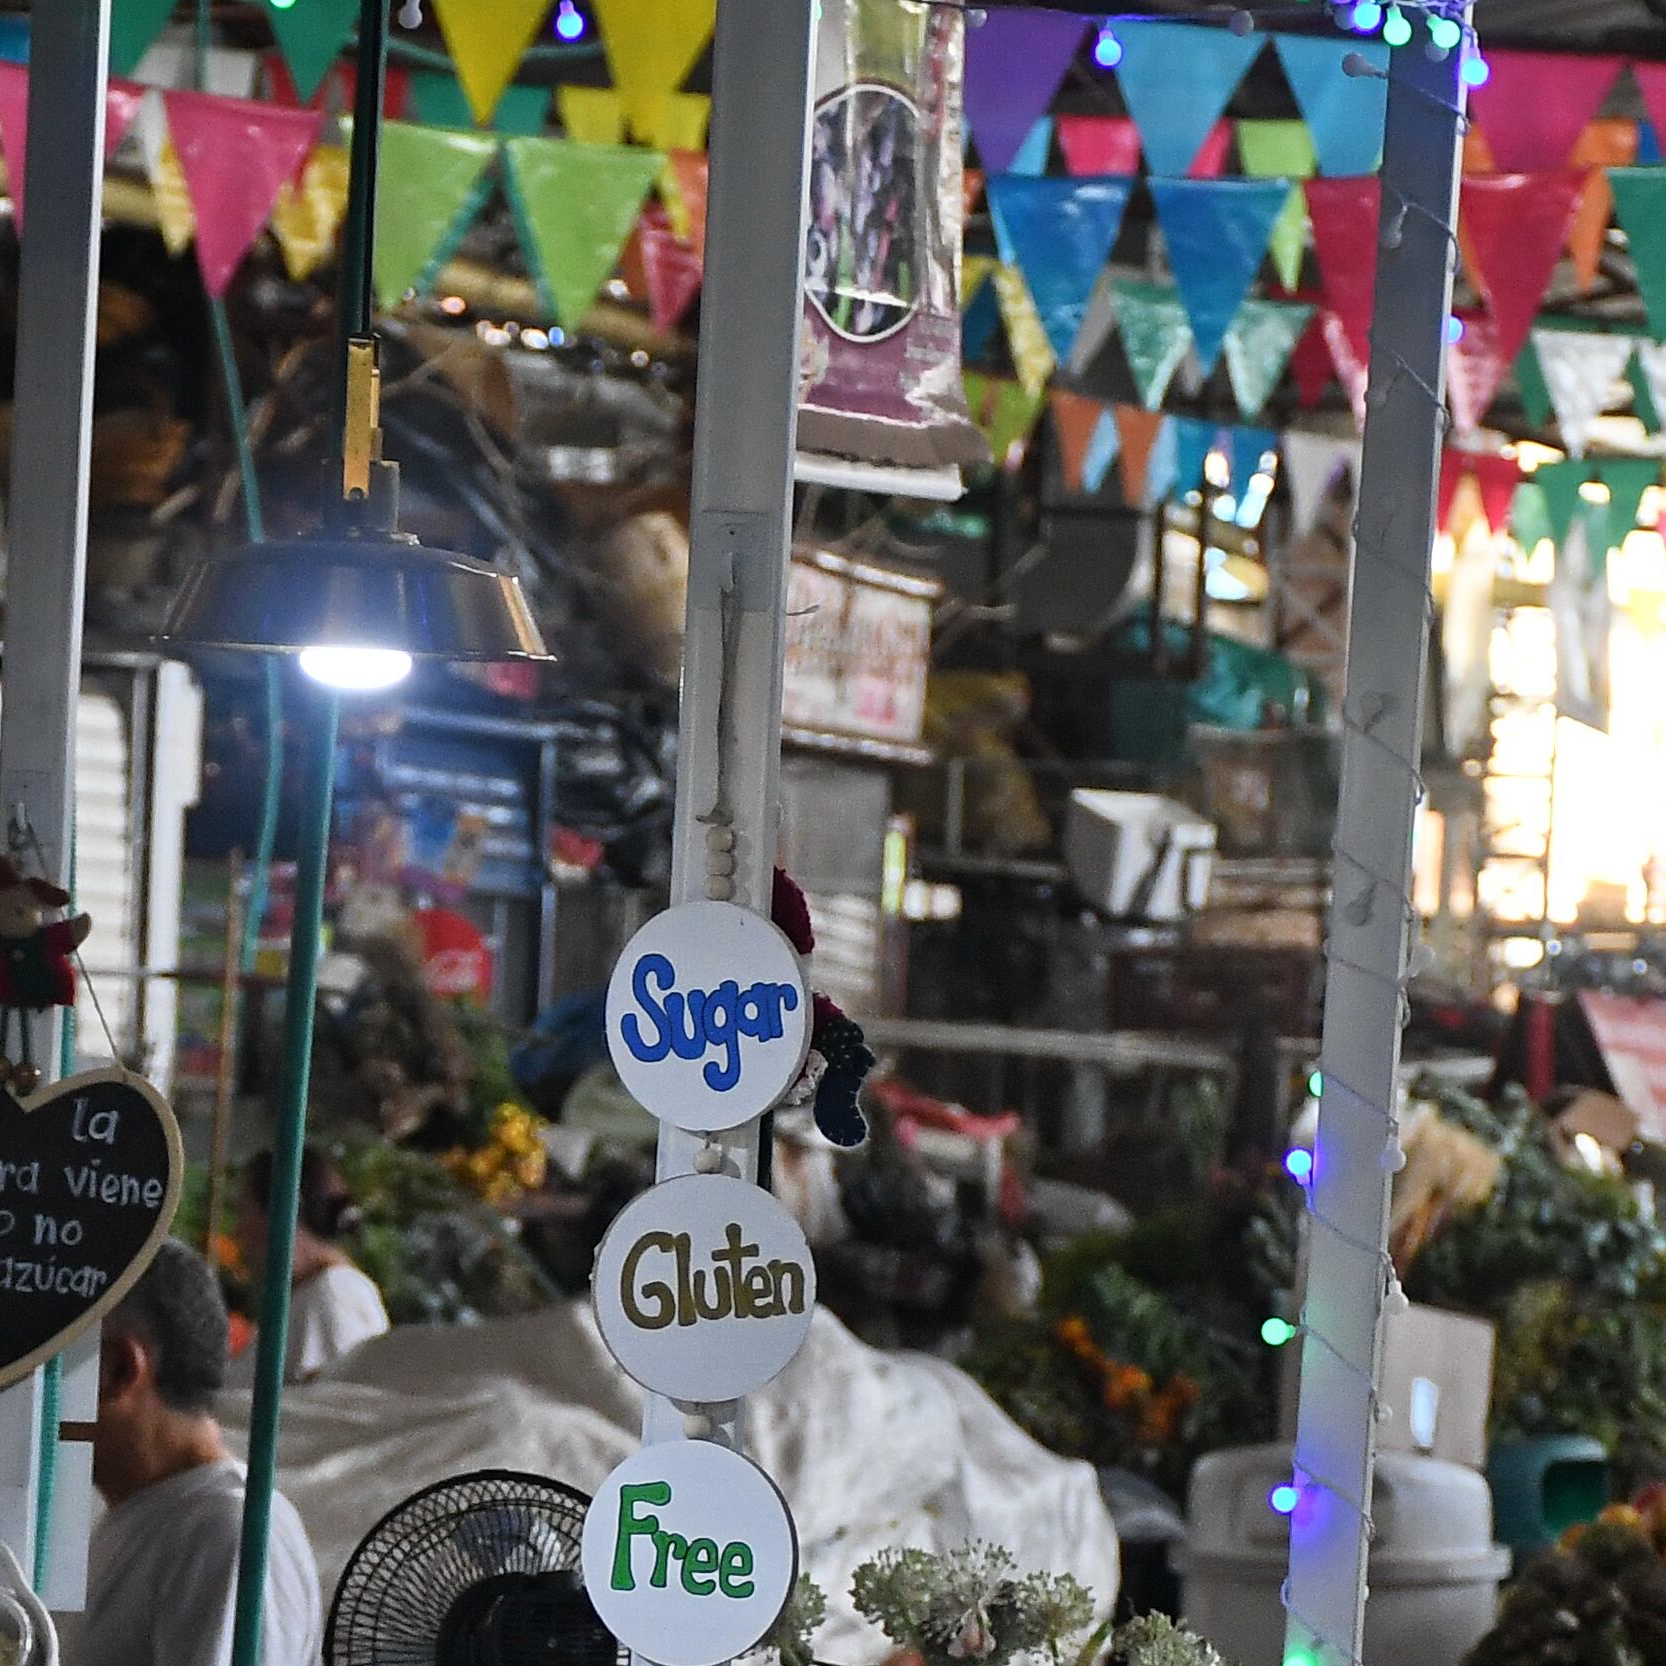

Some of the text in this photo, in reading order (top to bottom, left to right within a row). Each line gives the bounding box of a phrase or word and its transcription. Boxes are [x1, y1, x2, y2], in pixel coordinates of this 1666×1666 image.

[621, 953, 798, 1092] Sugar
[72, 1098, 120, 1144] la
[64, 1159, 164, 1210] viene
[34, 1212, 84, 1247] no
[620, 1223, 805, 1330] Gluten
[610, 1481, 755, 1598] Free
